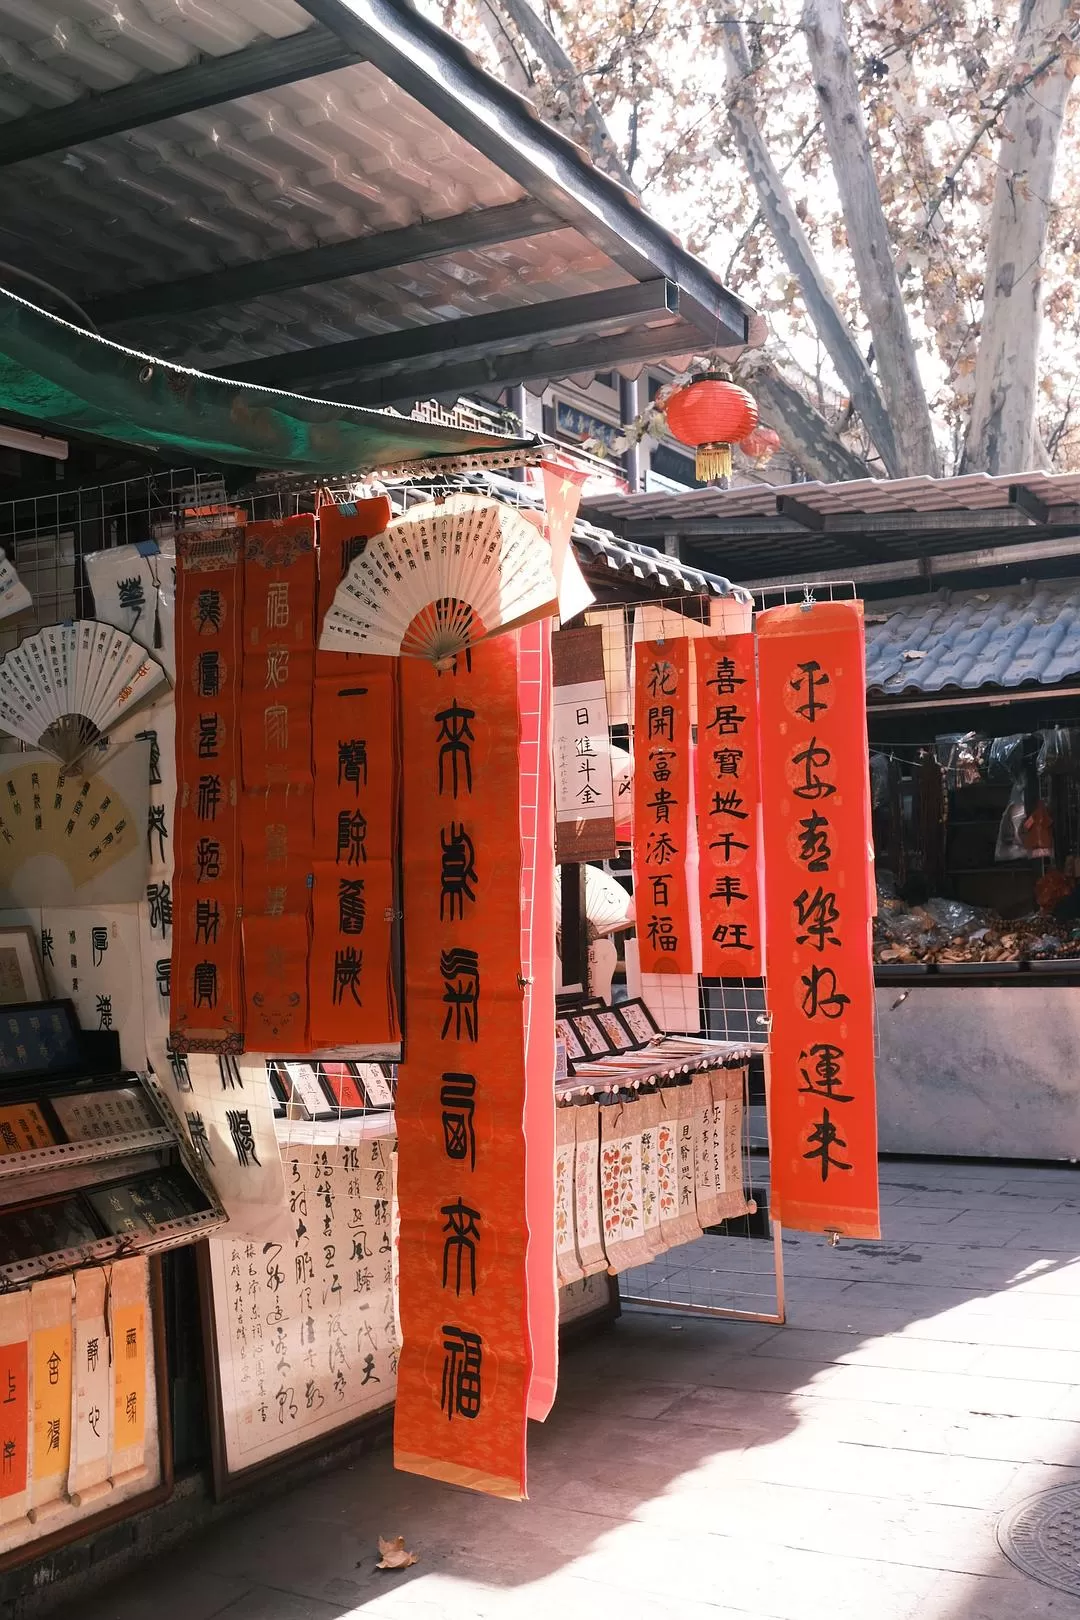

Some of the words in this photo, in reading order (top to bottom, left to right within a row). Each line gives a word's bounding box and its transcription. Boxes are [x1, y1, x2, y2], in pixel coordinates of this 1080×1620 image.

[574, 706, 603, 805] 日進斗金
[645, 660, 679, 953] 花開富貴添百福
[705, 655, 755, 951] 喜居寶地千年旺
